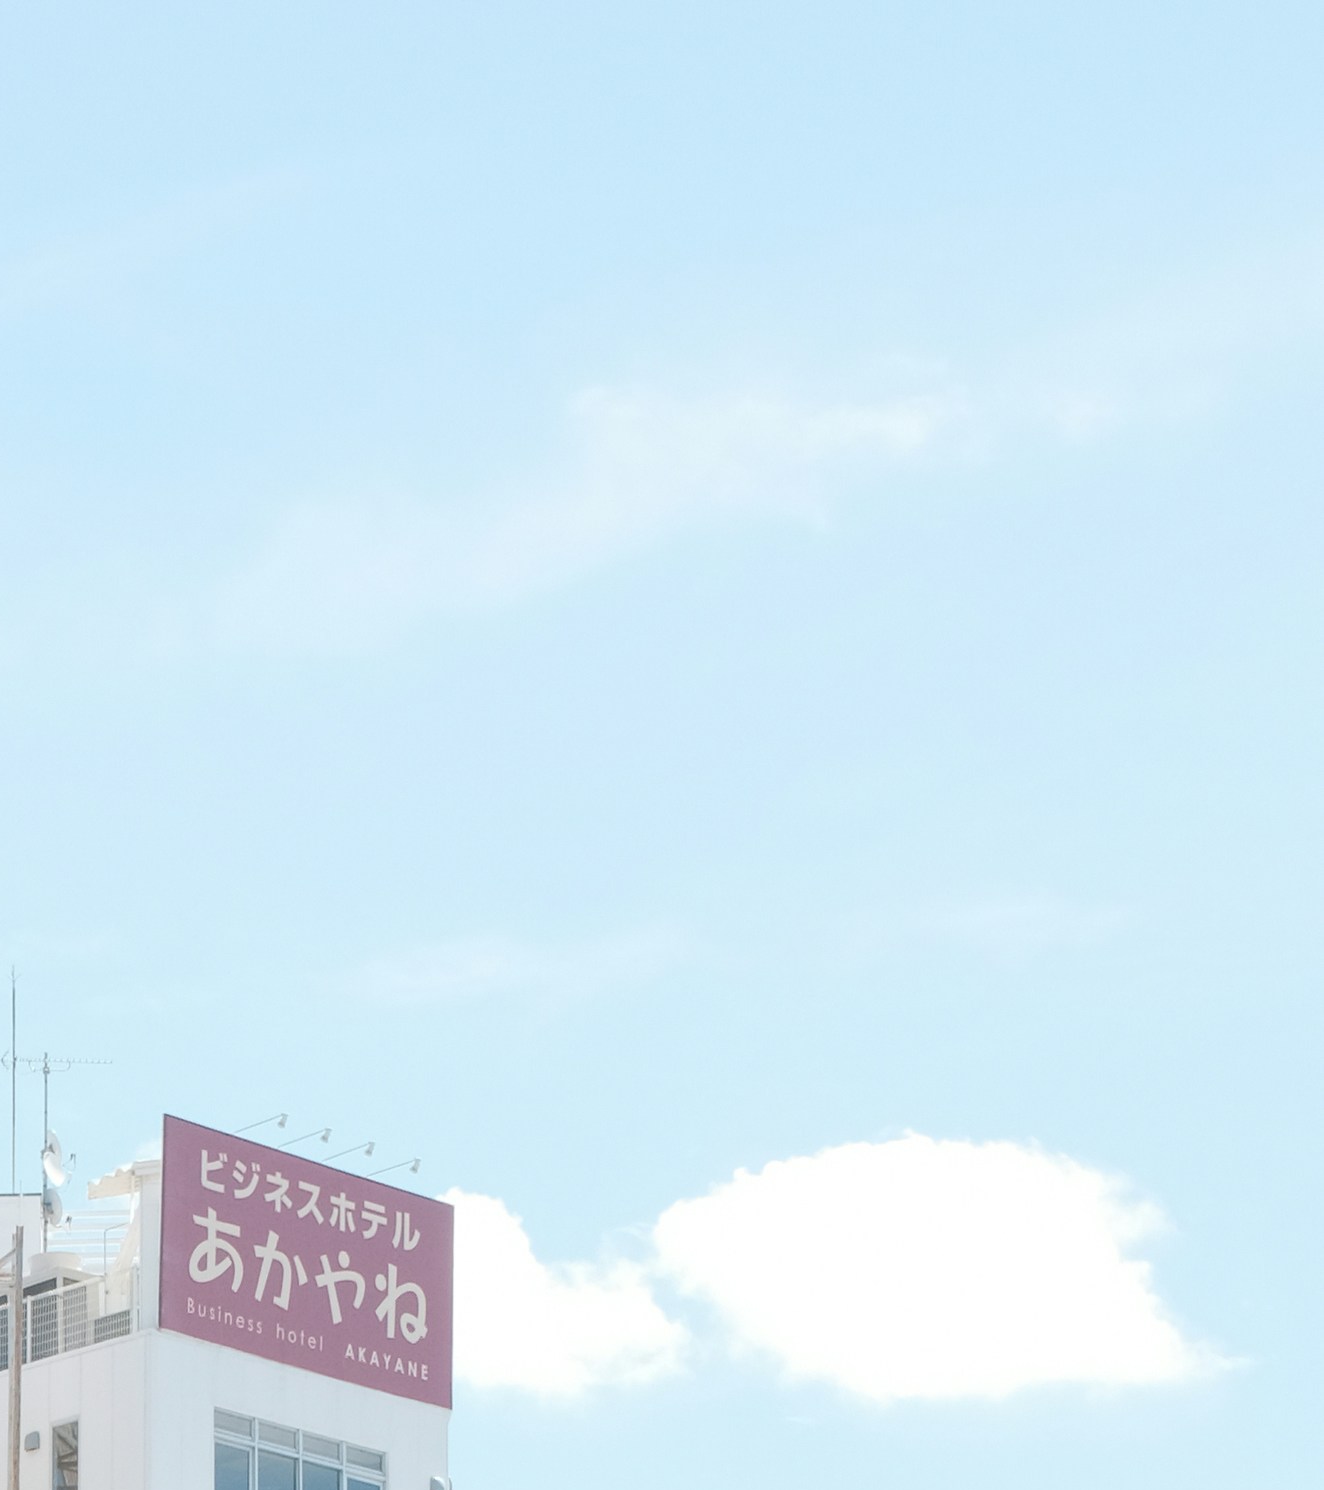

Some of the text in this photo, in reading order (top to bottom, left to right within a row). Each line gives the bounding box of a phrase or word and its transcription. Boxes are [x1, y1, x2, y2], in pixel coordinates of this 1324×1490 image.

[201, 1150, 420, 1251] ビジネスホテル
[189, 1206, 427, 1344] あかやね
[187, 1297, 429, 1380] Business hotel AKAYANE
